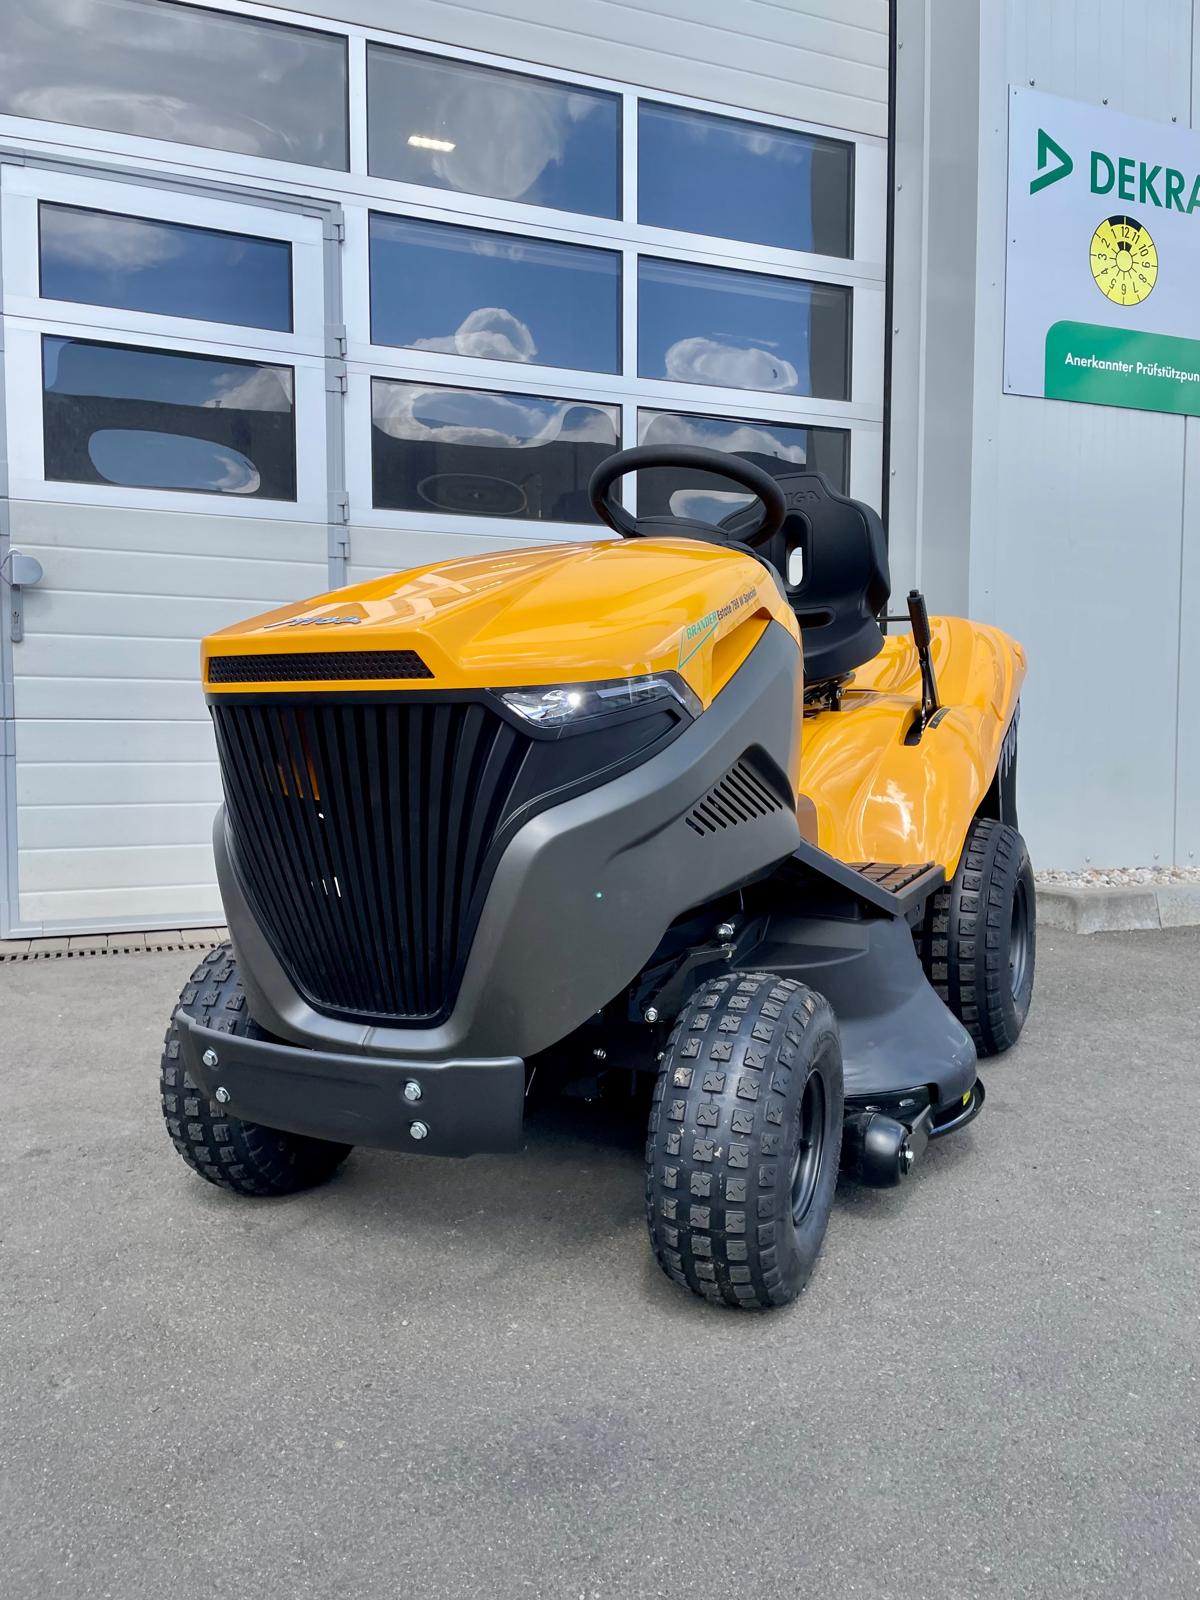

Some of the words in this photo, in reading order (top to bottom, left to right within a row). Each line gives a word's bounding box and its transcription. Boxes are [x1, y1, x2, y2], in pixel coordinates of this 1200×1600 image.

[1111, 228, 1117, 239] 1
[1121, 226, 1130, 239] 12
[1131, 231, 1140, 245] 11
[1101, 237, 1111, 248] 2
[1139, 243, 1149, 257] 10
[1097, 252, 1107, 261] 3
[1141, 261, 1151, 269] 9
[1101, 267, 1109, 275] 4
[1109, 278, 1117, 289] 5
[1138, 273, 1147, 283] 8
[1121, 283, 1127, 295] 6
[1132, 281, 1139, 293] 7
[1064, 352, 1134, 373] Anerkannter
[687, 611, 717, 640] BRANDER
